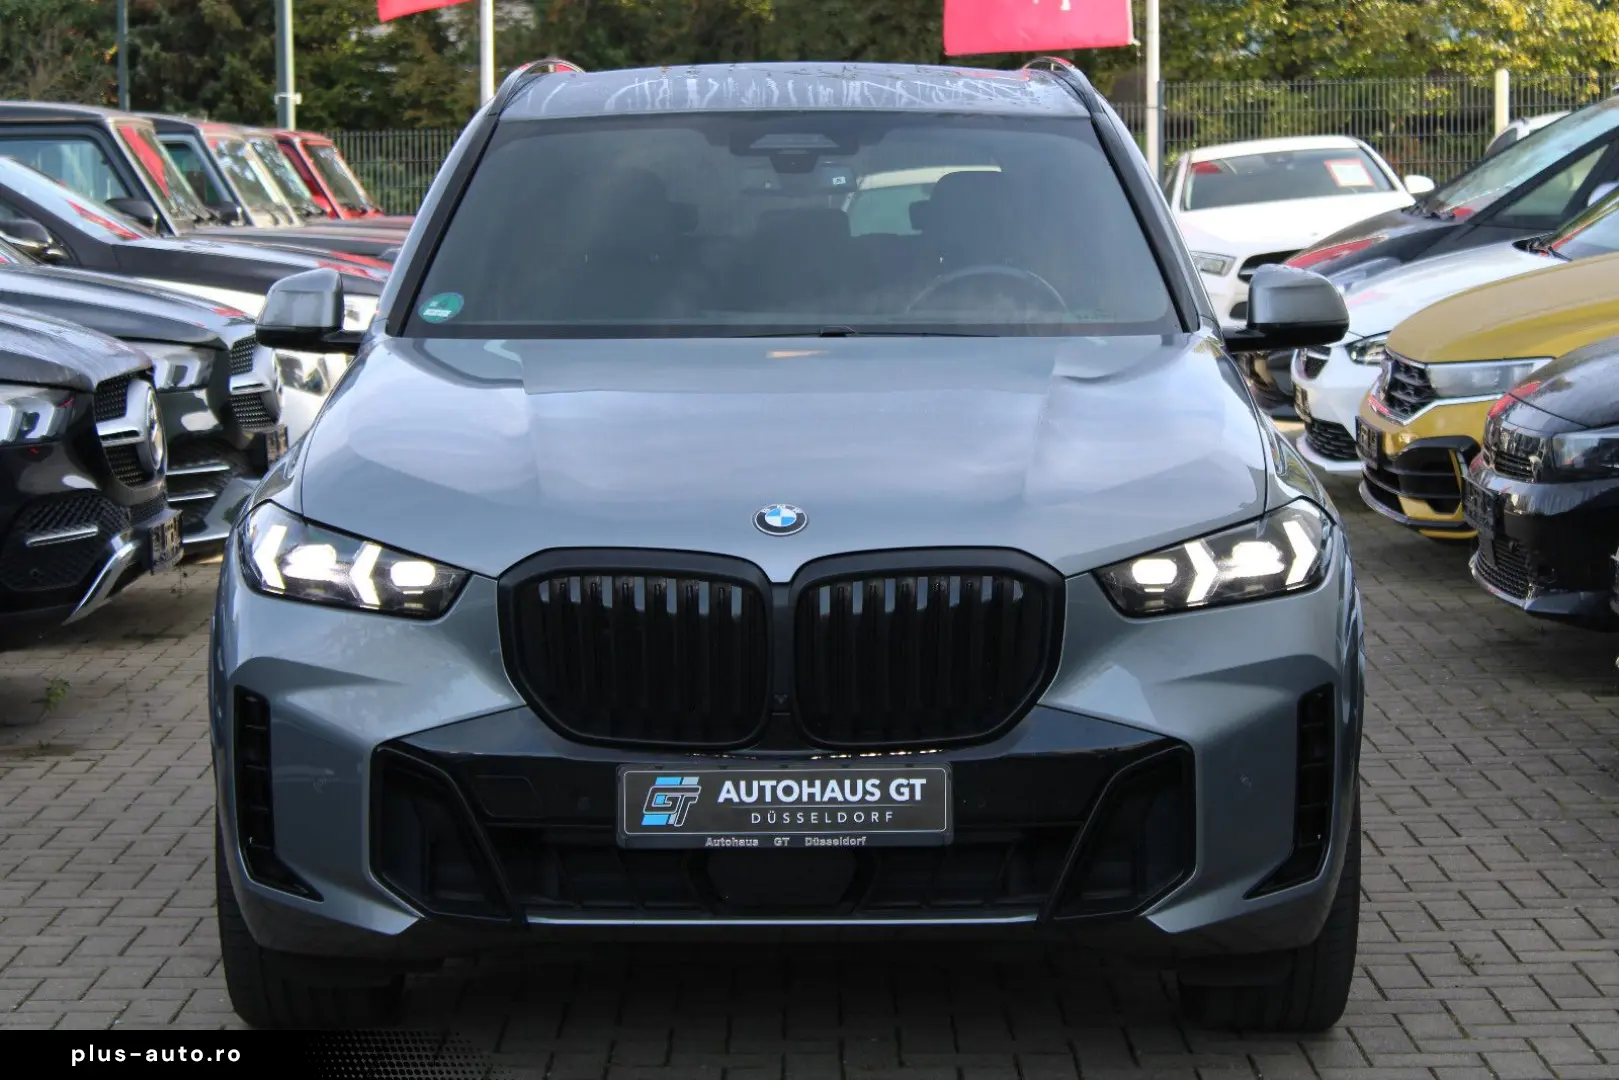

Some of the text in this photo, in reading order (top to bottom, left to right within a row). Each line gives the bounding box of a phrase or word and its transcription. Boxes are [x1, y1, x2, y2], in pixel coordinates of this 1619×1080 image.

[717, 778, 927, 803] AUTOHAUS GT
[751, 810, 893, 824] DÜSSELDORF
[705, 836, 867, 847] Autohaus GT Düsseldorf
